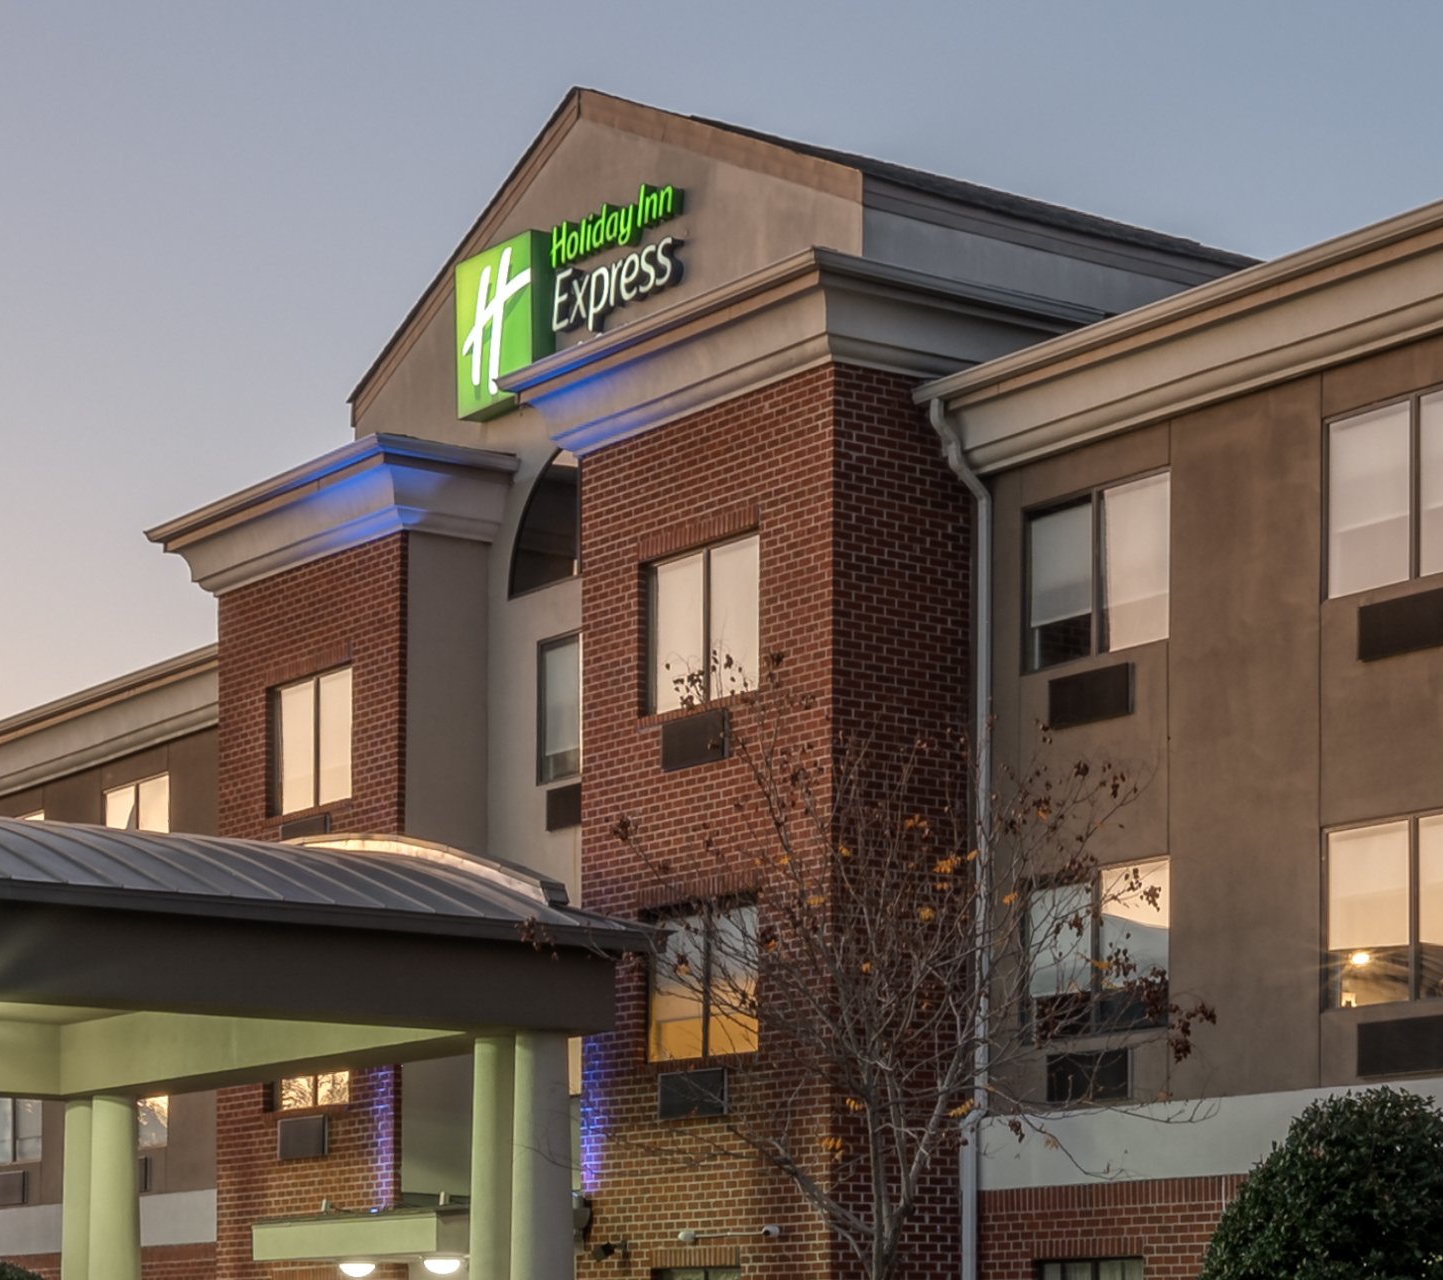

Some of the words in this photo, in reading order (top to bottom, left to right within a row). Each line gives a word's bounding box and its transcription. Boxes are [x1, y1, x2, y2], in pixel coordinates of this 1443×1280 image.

[550, 203, 634, 269] Holiday
[637, 183, 674, 228] Inn
[552, 237, 673, 332] Express
